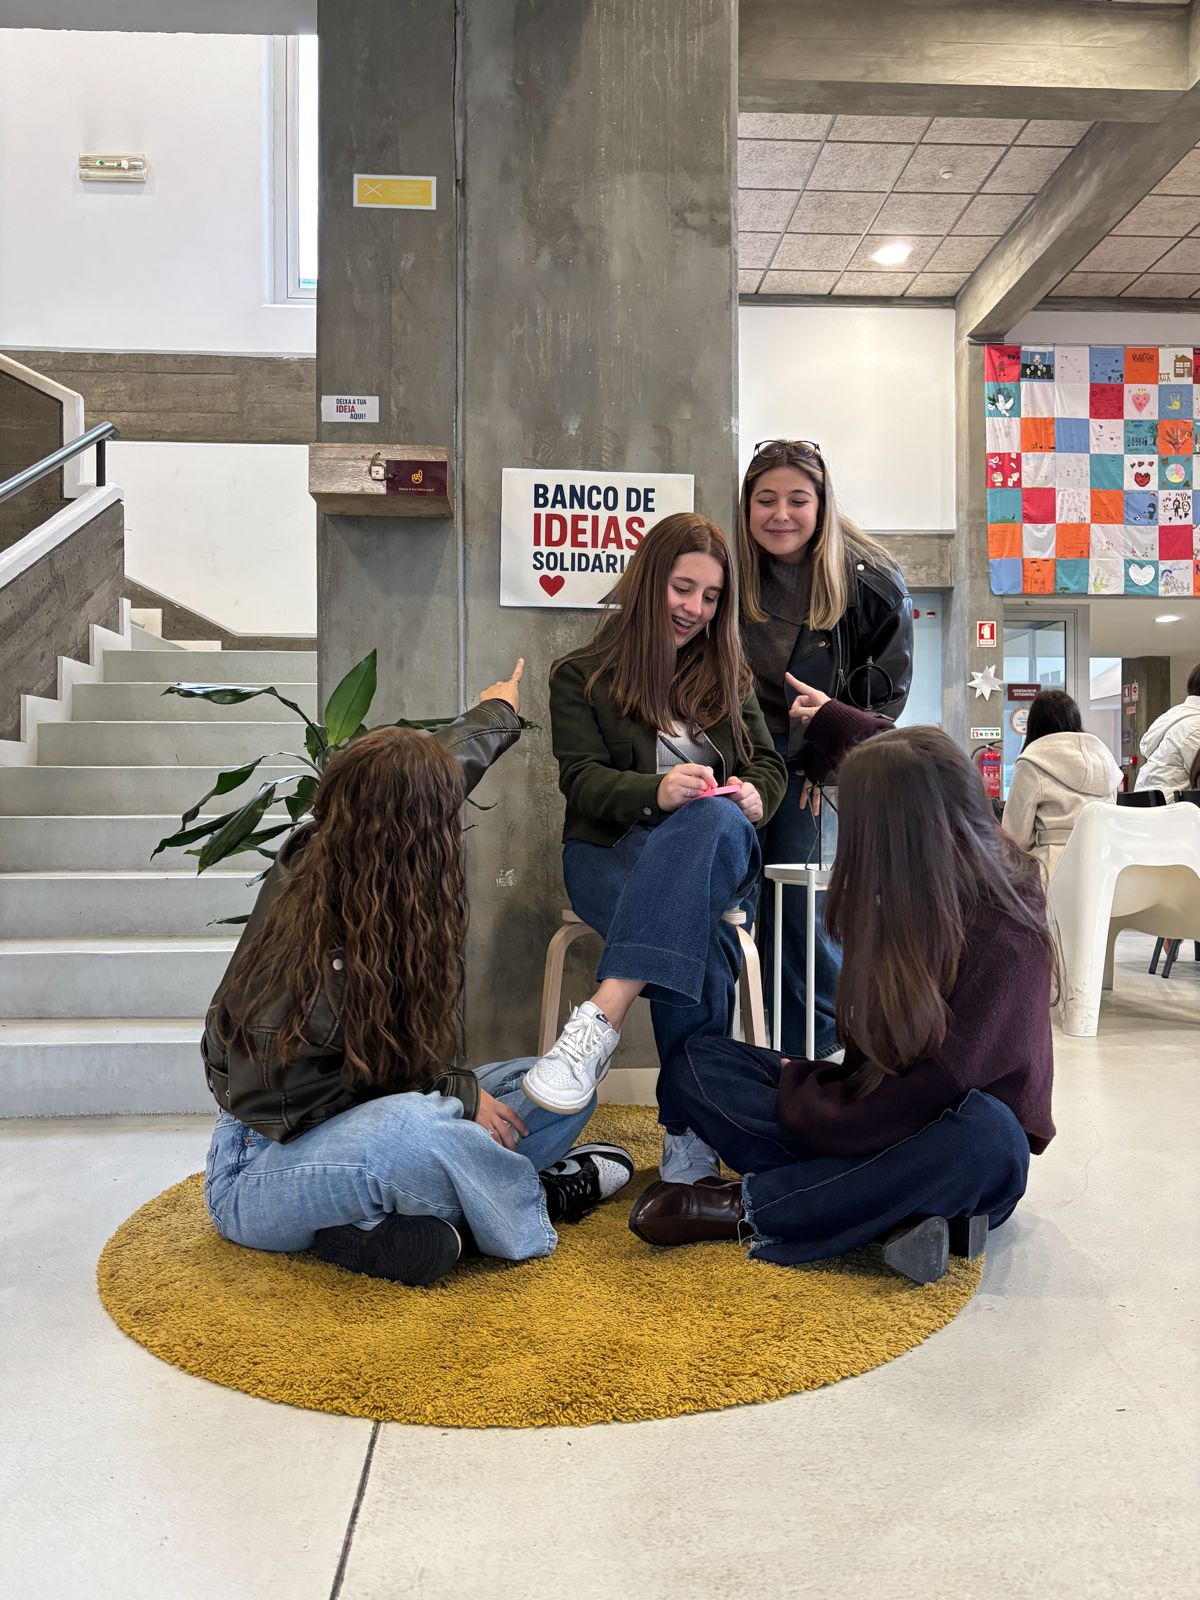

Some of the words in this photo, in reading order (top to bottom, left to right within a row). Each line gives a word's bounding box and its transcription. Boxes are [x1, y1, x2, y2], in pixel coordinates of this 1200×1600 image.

[336, 405, 356, 413] IDEIA
[350, 412, 367, 420] AQUI!
[533, 483, 619, 512] BANCO
[626, 487, 656, 513] DE
[532, 513, 646, 551] IDEIAS
[532, 550, 635, 574] SOLIDÁRI
